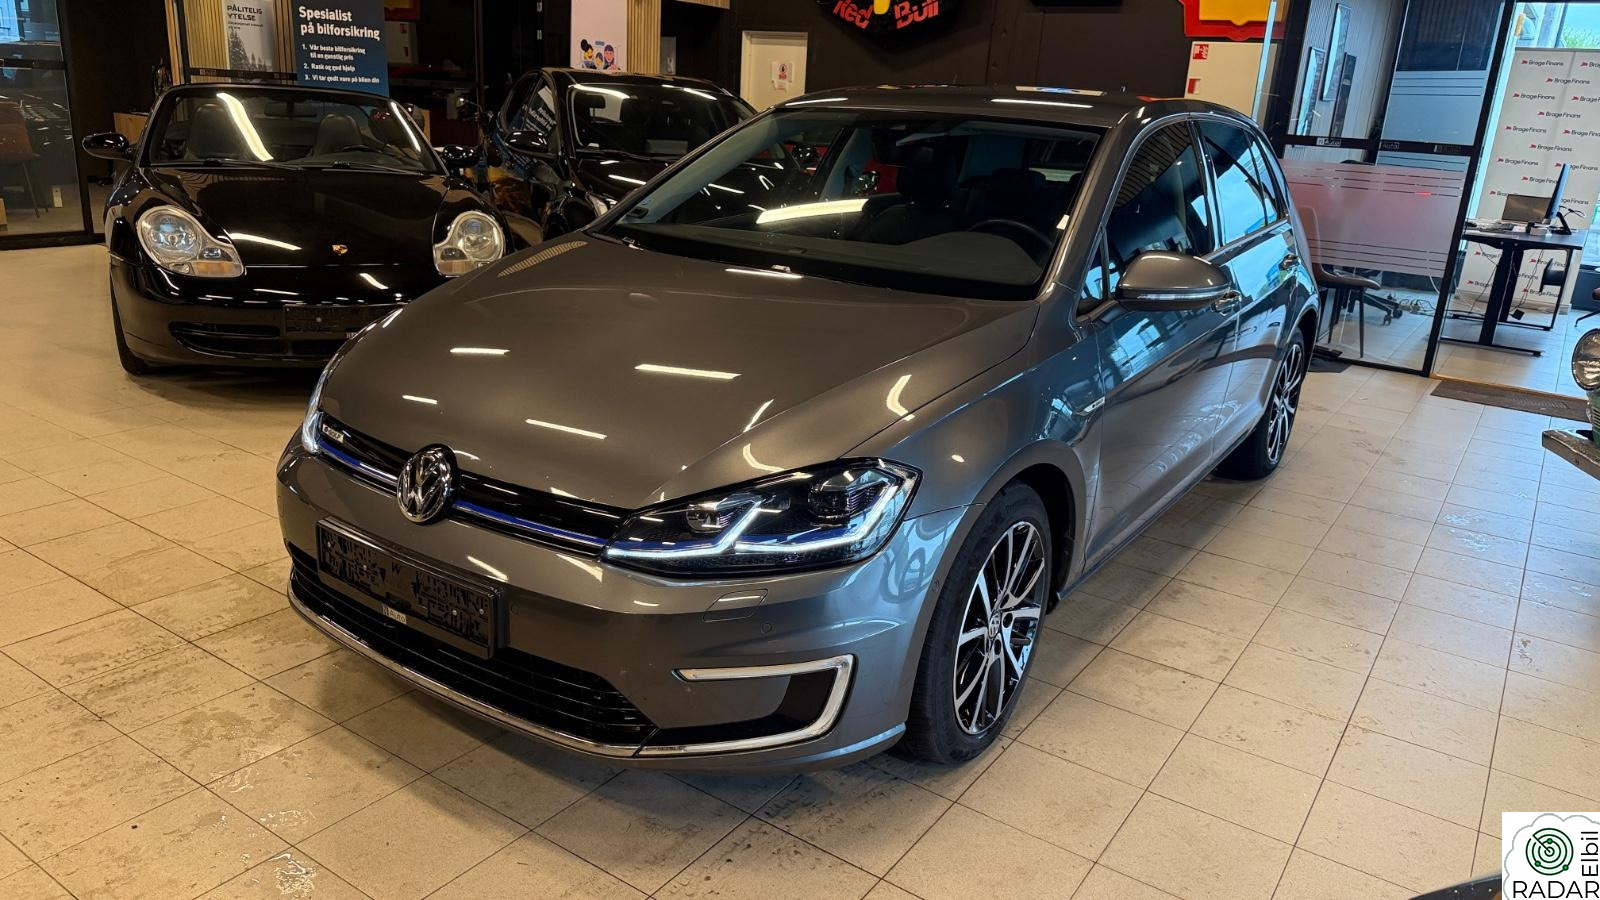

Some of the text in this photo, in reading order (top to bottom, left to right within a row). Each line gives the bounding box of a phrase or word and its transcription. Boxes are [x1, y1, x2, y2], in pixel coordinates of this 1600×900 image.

[227, 13, 256, 21] YTELSE
[299, 6, 352, 21] Spesialist
[894, 0, 939, 29] Bull
[300, 22, 380, 41] på bilforsikring
